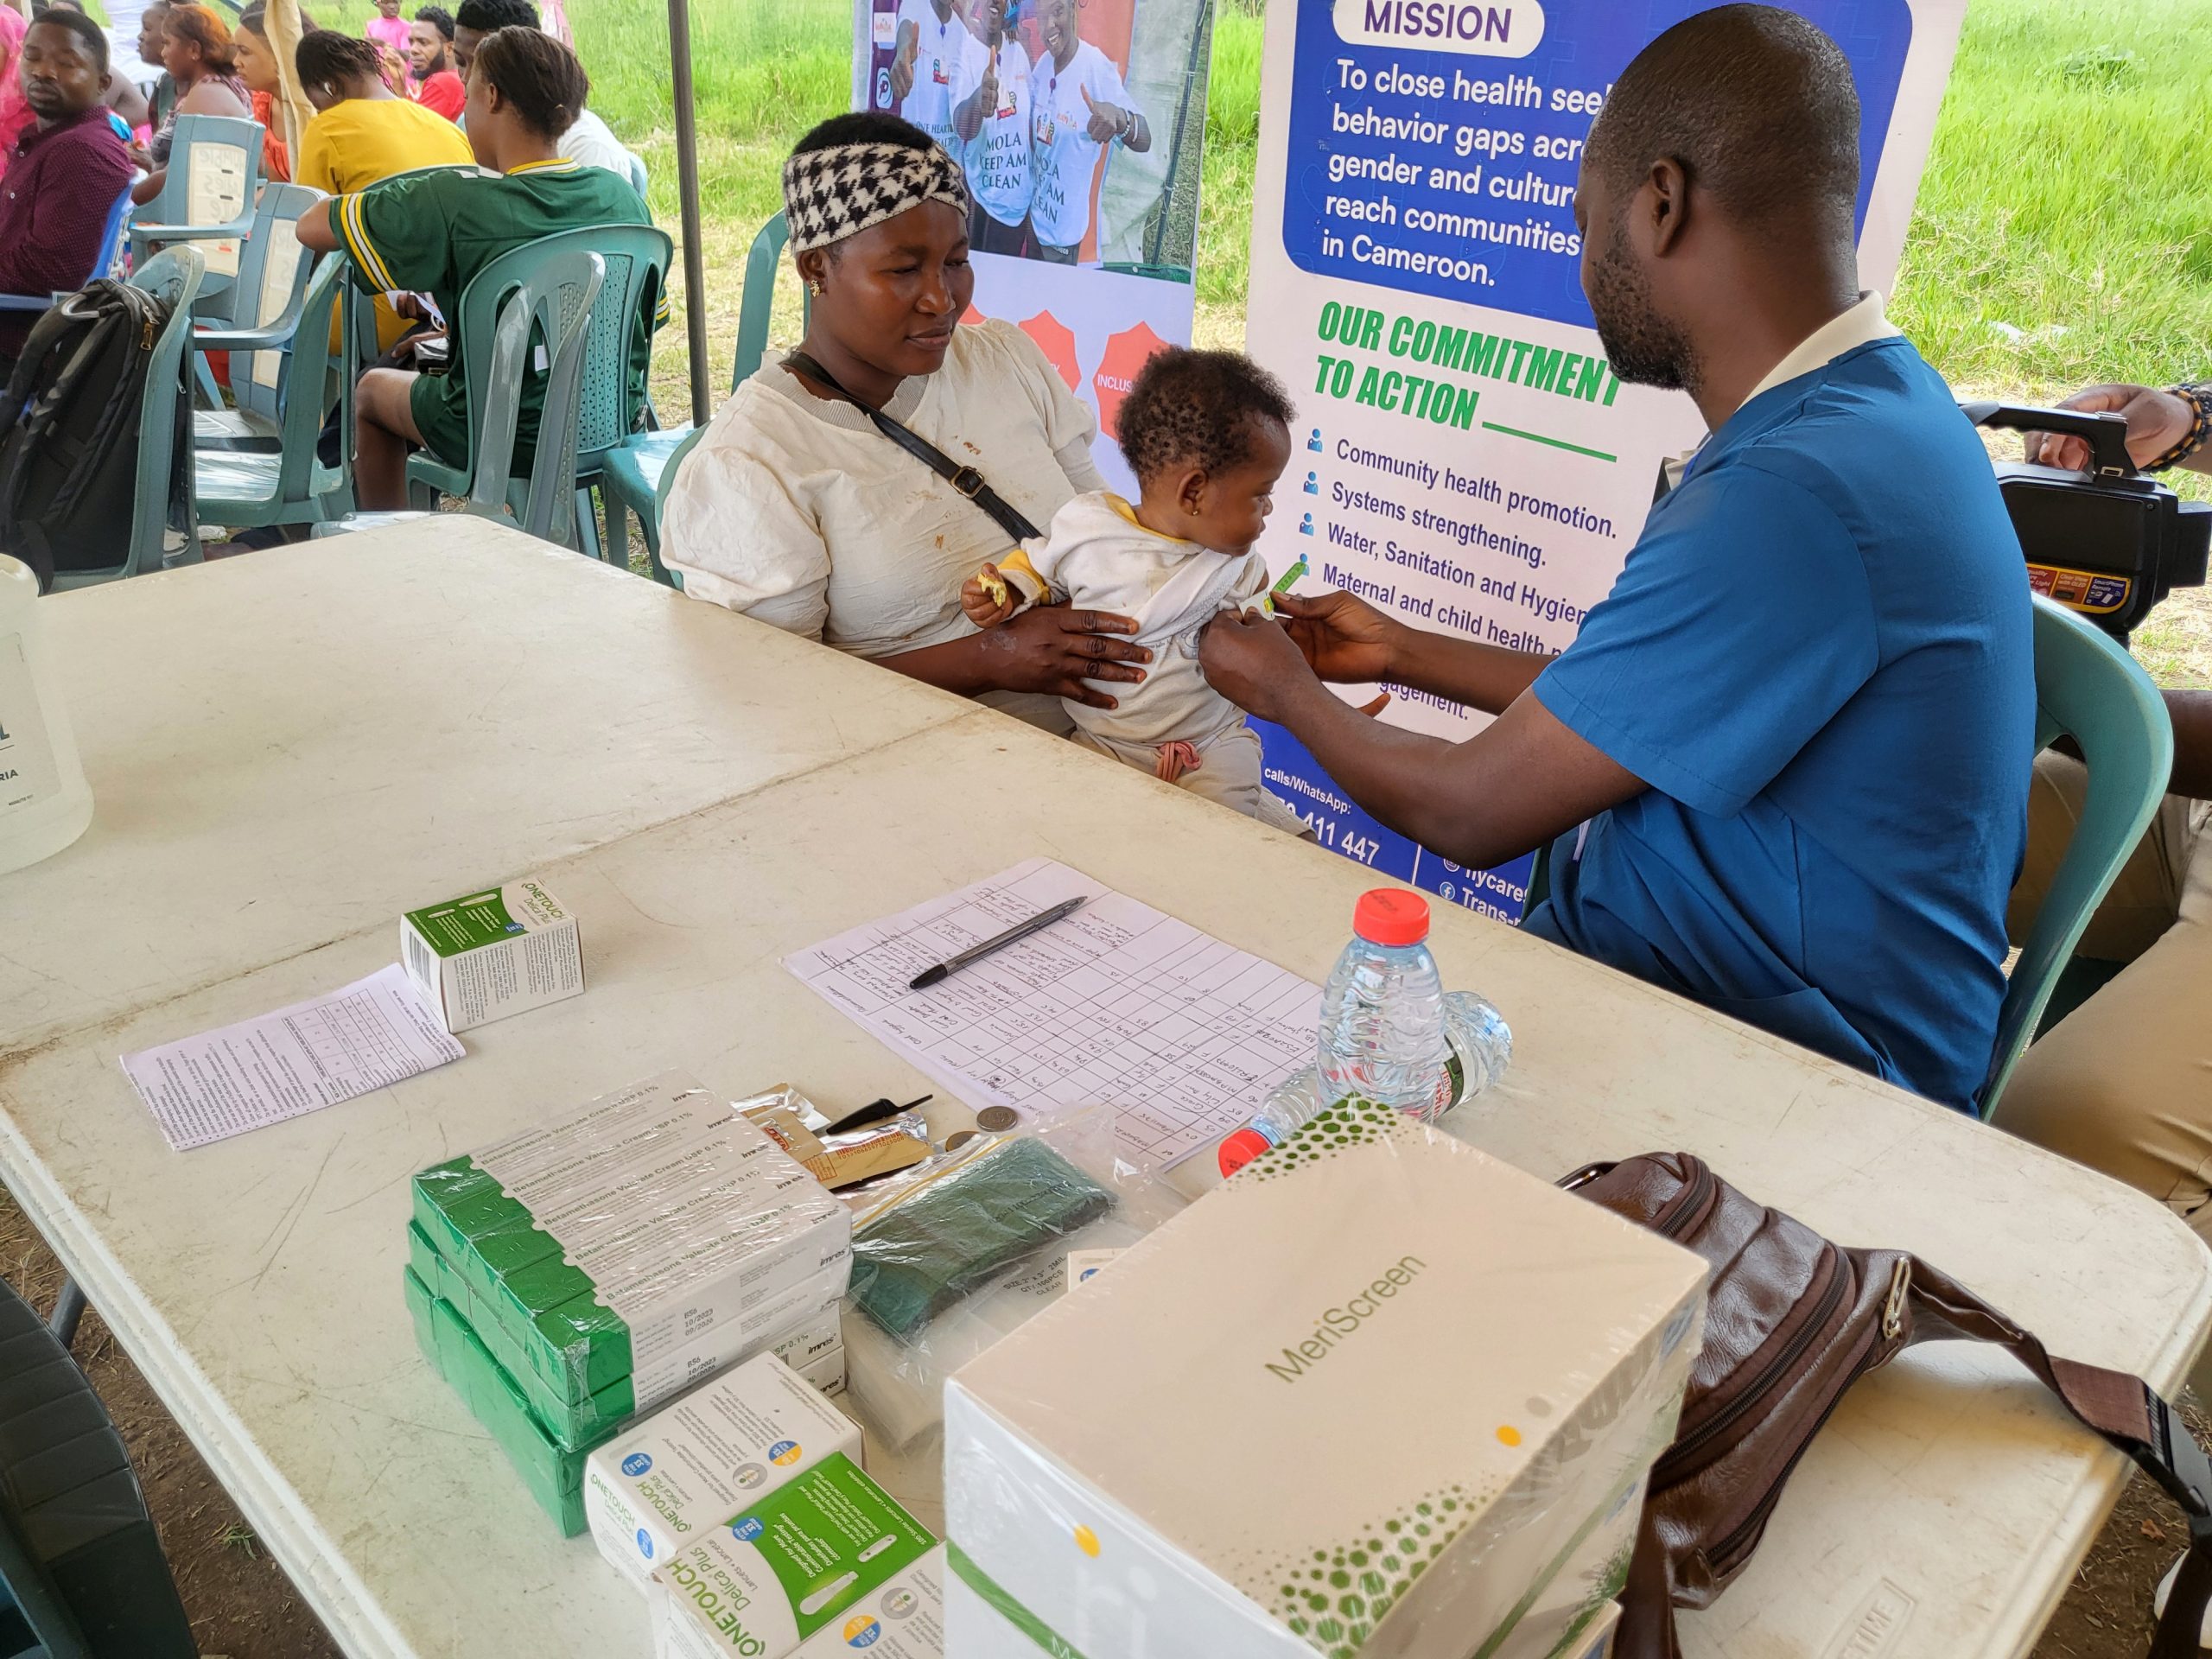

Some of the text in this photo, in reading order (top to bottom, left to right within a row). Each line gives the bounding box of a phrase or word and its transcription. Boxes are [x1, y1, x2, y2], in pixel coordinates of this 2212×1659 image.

[1363, 2, 1512, 43] MISSION
[1337, 59, 1613, 116] To close health see
[985, 131, 1022, 153] MOLA
[1332, 103, 1585, 162] behavior gaps acr
[978, 153, 1027, 170] KEEP AM
[1328, 154, 1578, 207] gender and cultur
[982, 173, 1022, 189] CLEAN
[1325, 194, 1581, 257] reach communities
[1321, 229, 1496, 287] in Cameroon.
[1318, 302, 1623, 408] OUR COMMITMENT
[1097, 373, 1134, 394] INCLUS
[1314, 355, 1479, 432] TO ACTION
[1337, 438, 1618, 540] Community health promotion.
[1332, 481, 1548, 569] Systems strengthening.
[1328, 523, 1379, 562] Water,
[1384, 541, 1475, 588] Sanitation
[1480, 569, 1516, 603] and
[1323, 563, 1395, 606] Maternal
[1400, 584, 1433, 619] and
[1437, 599, 1482, 637] child
[1487, 618, 1545, 656] health
[1264, 766, 1351, 815] calls/WhatsApp:
[1341, 831, 1380, 866] 447
[480, 1134, 552, 1164] Betamethasone
[620, 1129, 652, 1144] Cream
[543, 1190, 617, 1224] Betamethasone
[653, 1158, 684, 1174] Cream
[820, 1246, 845, 1268] imres
[1048, 1255, 1065, 1271] 2MIL
[1036, 1281, 1063, 1296] CLEAR
[685, 1306, 712, 1328] 10/2023
[1263, 1250, 1430, 1384] MeriScreen
[688, 1355, 715, 1377] 10/2023
[774, 1344, 786, 1355] SP
[634, 1482, 691, 1532] ONETOUCH
[885, 1506, 903, 1522] Lancets
[797, 1529, 810, 1541] para
[688, 1546, 715, 1572] Plus
[772, 1534, 816, 1577] Designed for More
[792, 1541, 823, 1571] Comfortable
[733, 1567, 757, 1591] Lancets
[666, 1560, 765, 1658] ONETOUCH
